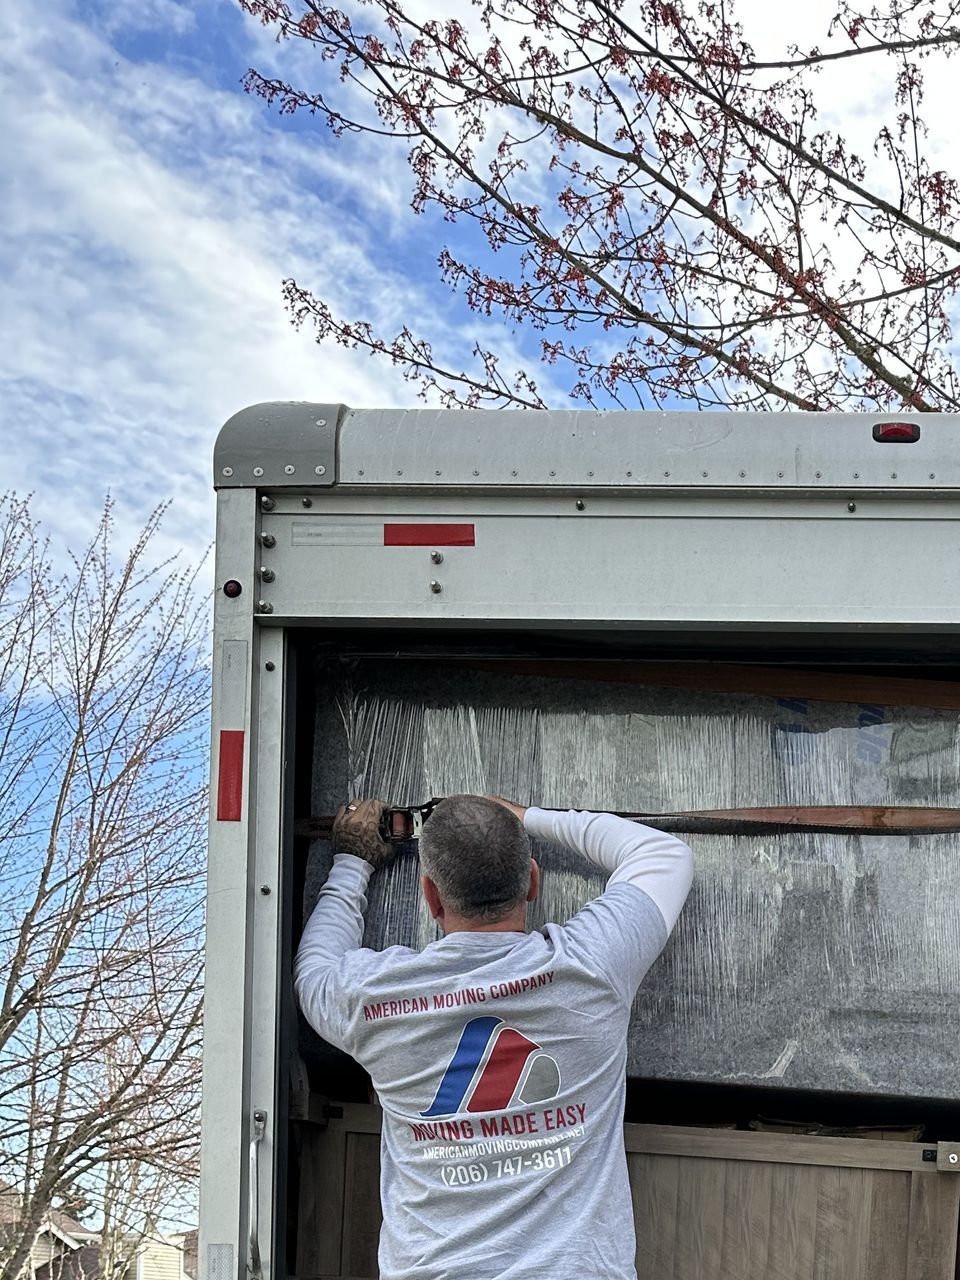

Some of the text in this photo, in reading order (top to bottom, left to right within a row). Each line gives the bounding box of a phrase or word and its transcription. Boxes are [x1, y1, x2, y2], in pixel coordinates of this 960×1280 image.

[363, 971, 555, 1022] AMERICAN MOVING COMPANY
[408, 1103, 588, 1142] MOVING MADE EASY
[441, 1146, 573, 1187] (206) 747-3611
